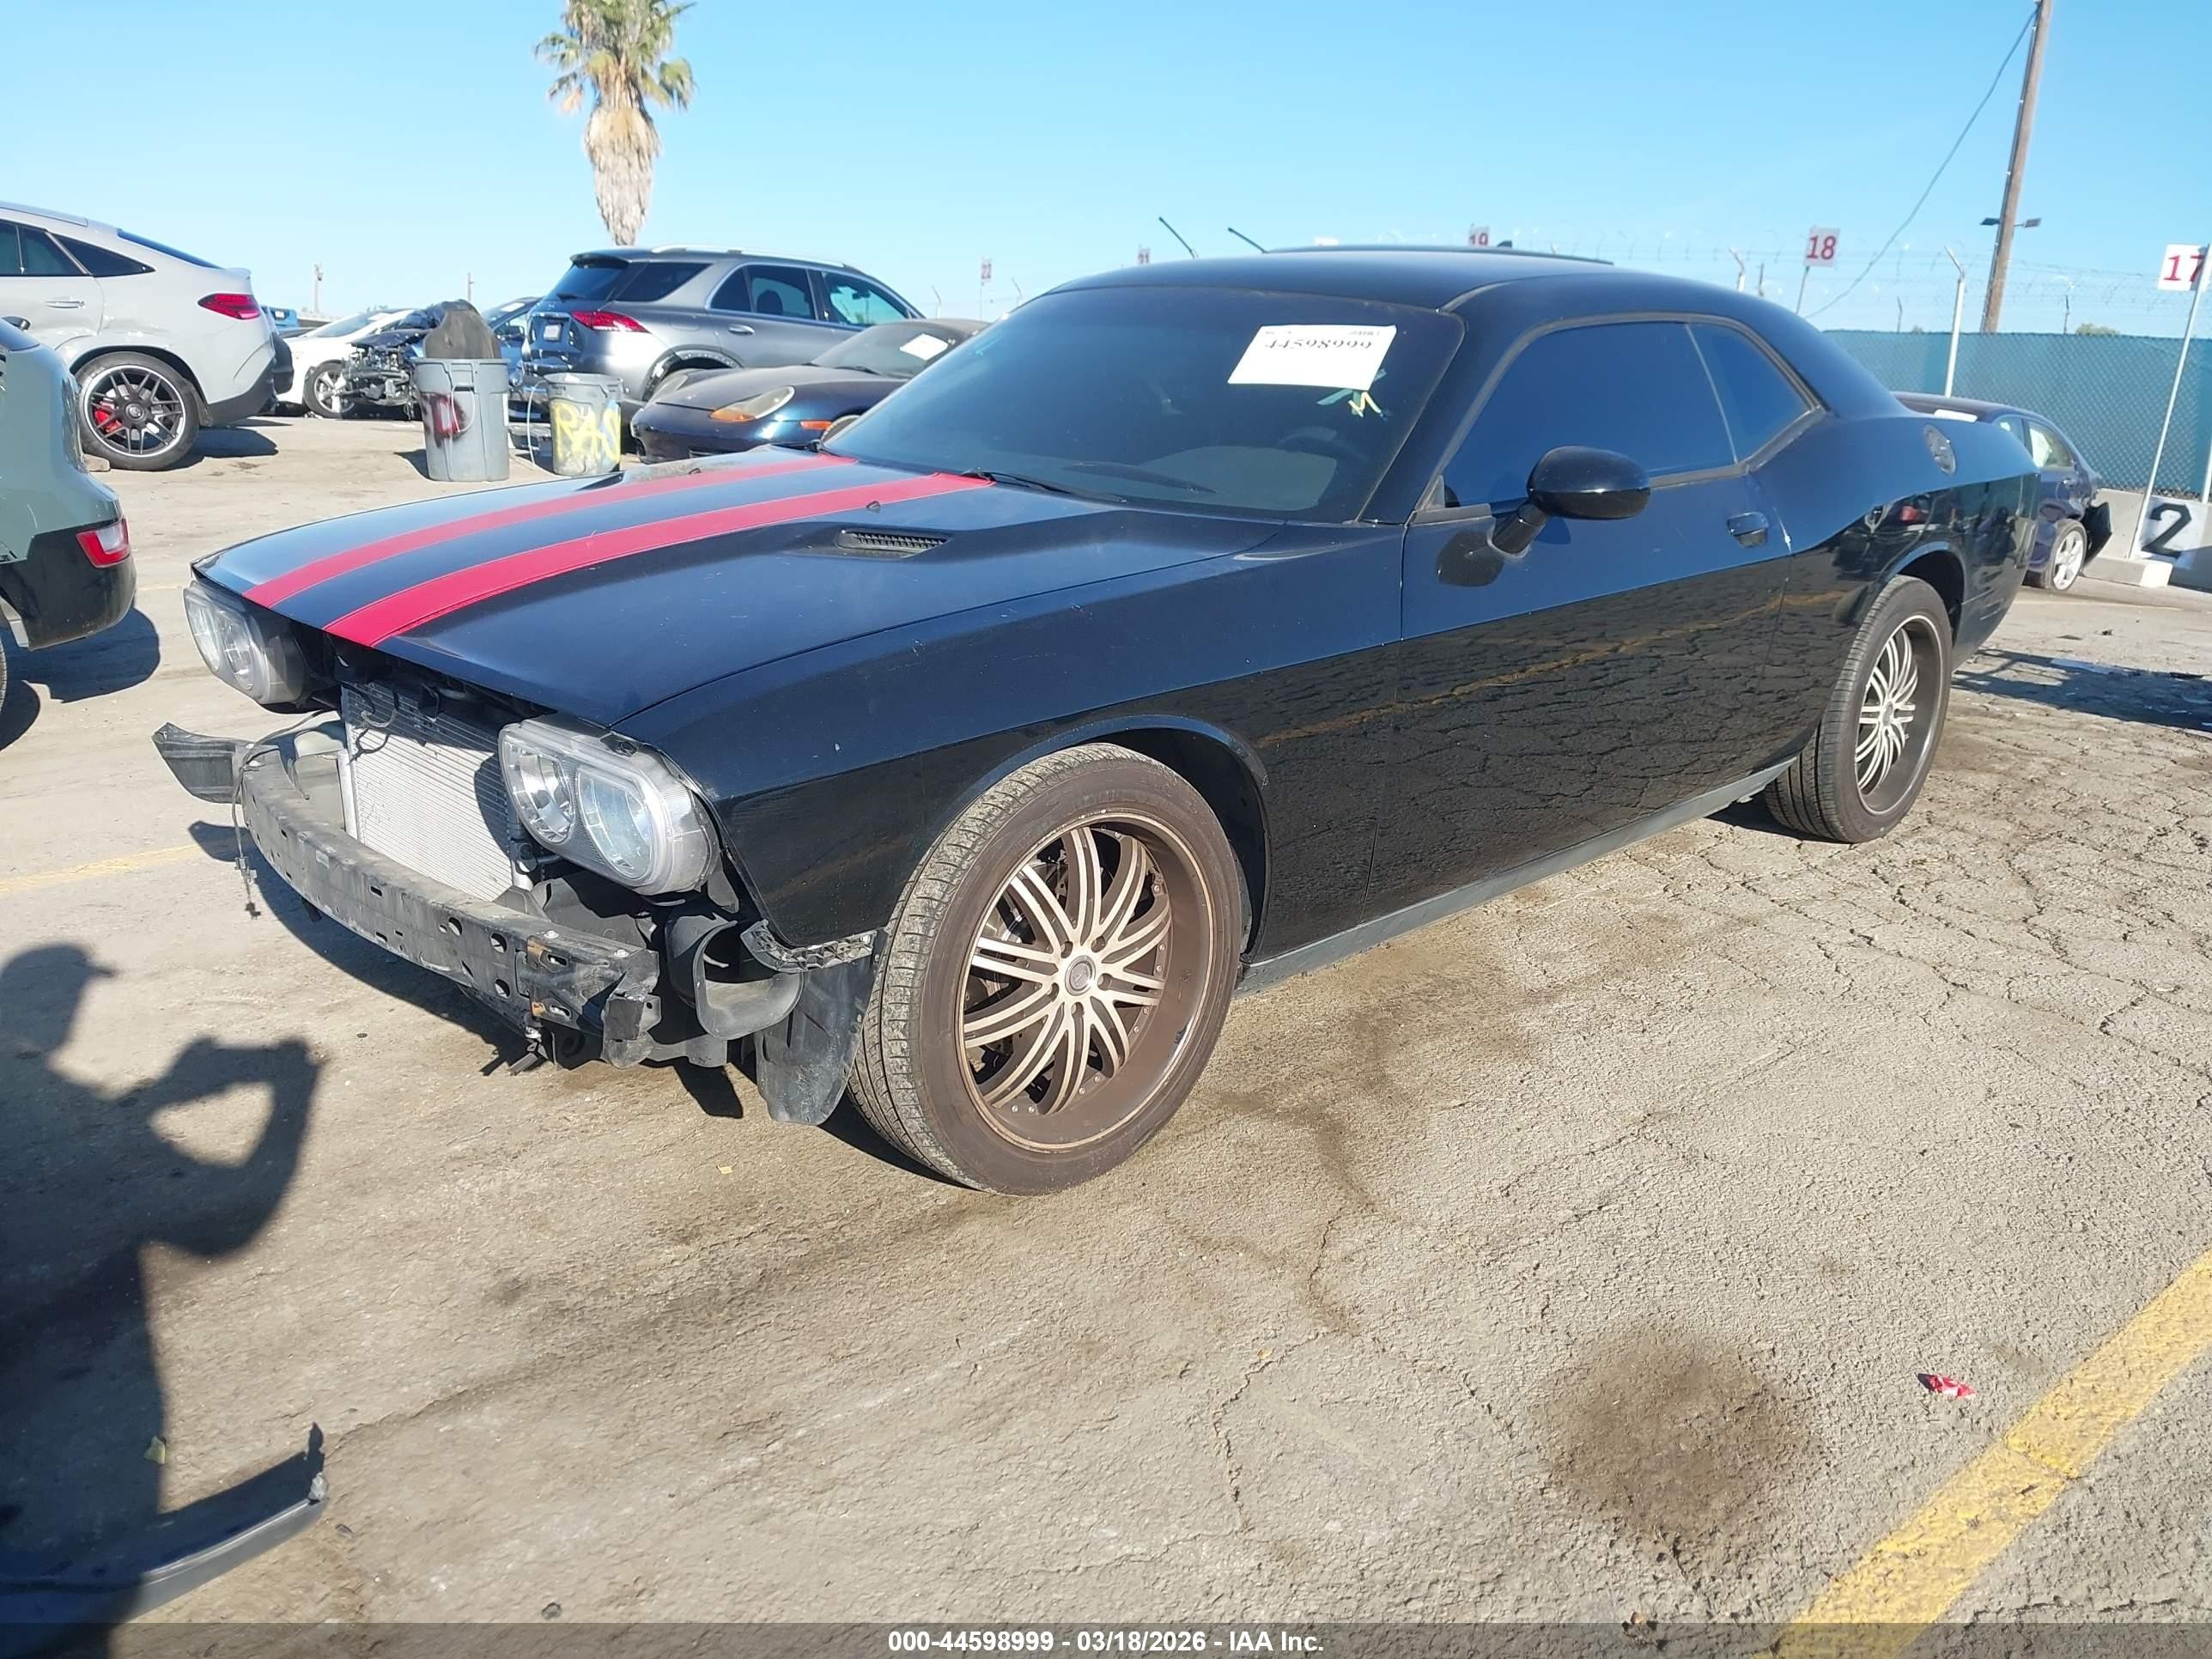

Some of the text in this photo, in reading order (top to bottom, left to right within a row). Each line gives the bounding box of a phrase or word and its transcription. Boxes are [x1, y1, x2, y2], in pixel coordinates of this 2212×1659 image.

[1807, 235, 1836, 260] 18
[2164, 255, 2205, 282] 17
[2142, 502, 2191, 559] 2
